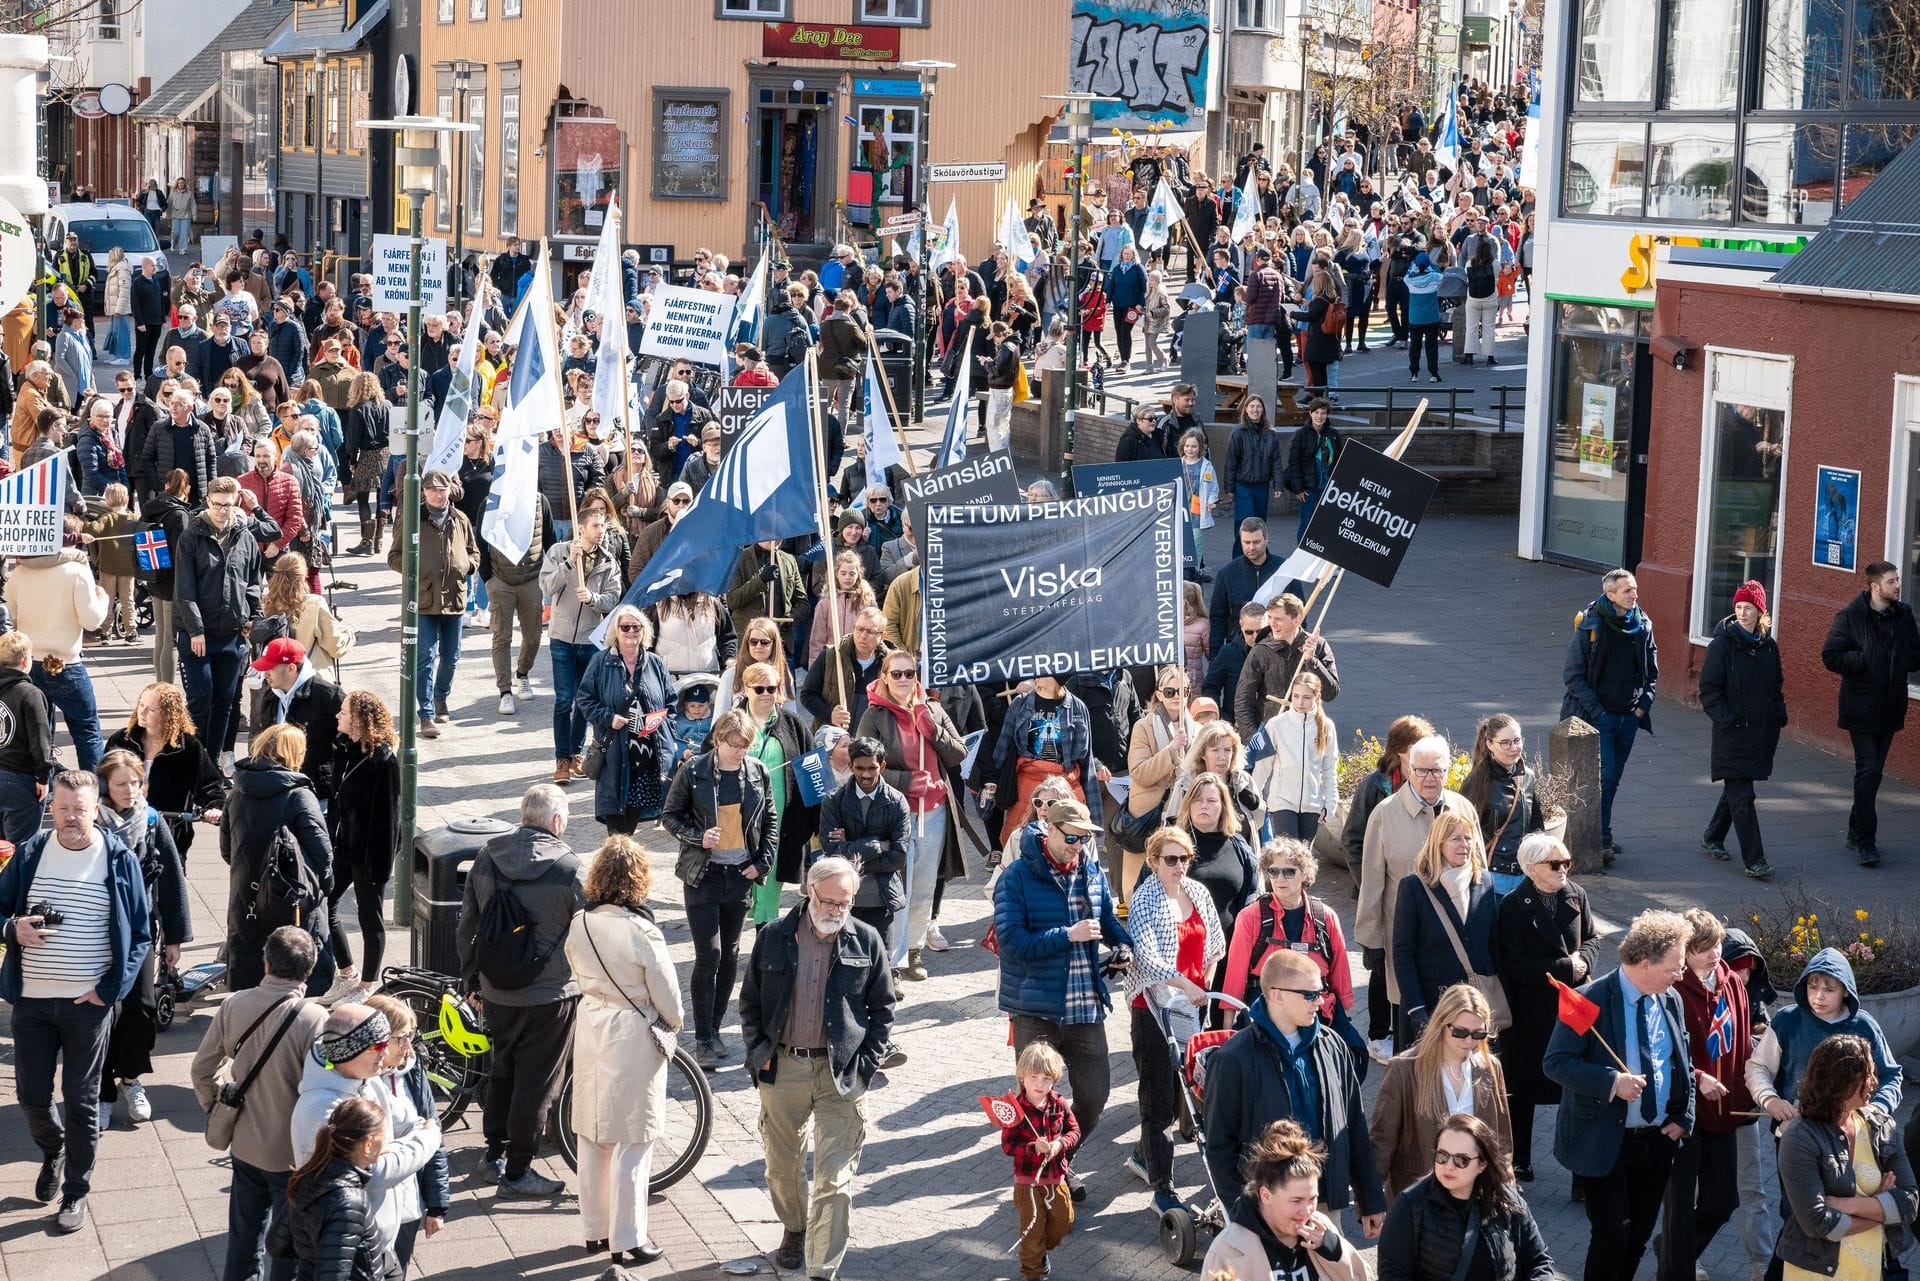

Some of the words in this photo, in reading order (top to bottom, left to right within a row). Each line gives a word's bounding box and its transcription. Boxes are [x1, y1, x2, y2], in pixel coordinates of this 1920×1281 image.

[790, 25, 830, 47] Aroy
[832, 28, 862, 45] Dee
[664, 103, 718, 117] Authentic
[663, 119, 688, 133] Thai
[690, 120, 718, 133] Food
[668, 136, 713, 151] Upstairs
[661, 154, 672, 162] on
[673, 153, 699, 162] second
[376, 276, 386, 286] AÐ
[388, 277, 407, 287] VERA
[384, 288, 410, 301] KRÓNU
[664, 297, 716, 315] FJÁRFESTING
[666, 311, 706, 326] MENNTUN
[706, 316, 713, 326] Á
[650, 322, 661, 332] AÐ
[663, 323, 684, 335] VERA
[685, 327, 722, 341] HVERRAR
[656, 335, 684, 347] KRÓNU
[686, 339, 710, 351] VIRÐI!
[903, 455, 1012, 502] Námslán
[1359, 477, 1392, 499] METUM
[927, 504, 1020, 525] METUM
[1028, 487, 1154, 521] ÞEKKINGU
[1156, 487, 1173, 513] AÐ
[1320, 479, 1417, 539] þekkingu
[0, 509, 20, 525] TAX
[26, 510, 56, 526] FREE
[1340, 517, 1356, 529] AÐ
[0, 544, 13, 553] AVE
[16, 544, 25, 553] UP
[29, 544, 37, 553] TO
[1305, 538, 1325, 553] Viska
[1338, 526, 1391, 557] VERÐLEIKUM
[927, 528, 945, 593] METUM
[1000, 563, 1103, 599] Viska
[1154, 515, 1175, 640] VERÐLEIKUM
[930, 597, 948, 686] ÞEKKINGU
[952, 661, 991, 684] AÐ
[997, 641, 1175, 680] VERÐLEIKUM
[810, 772, 827, 798] BHM
